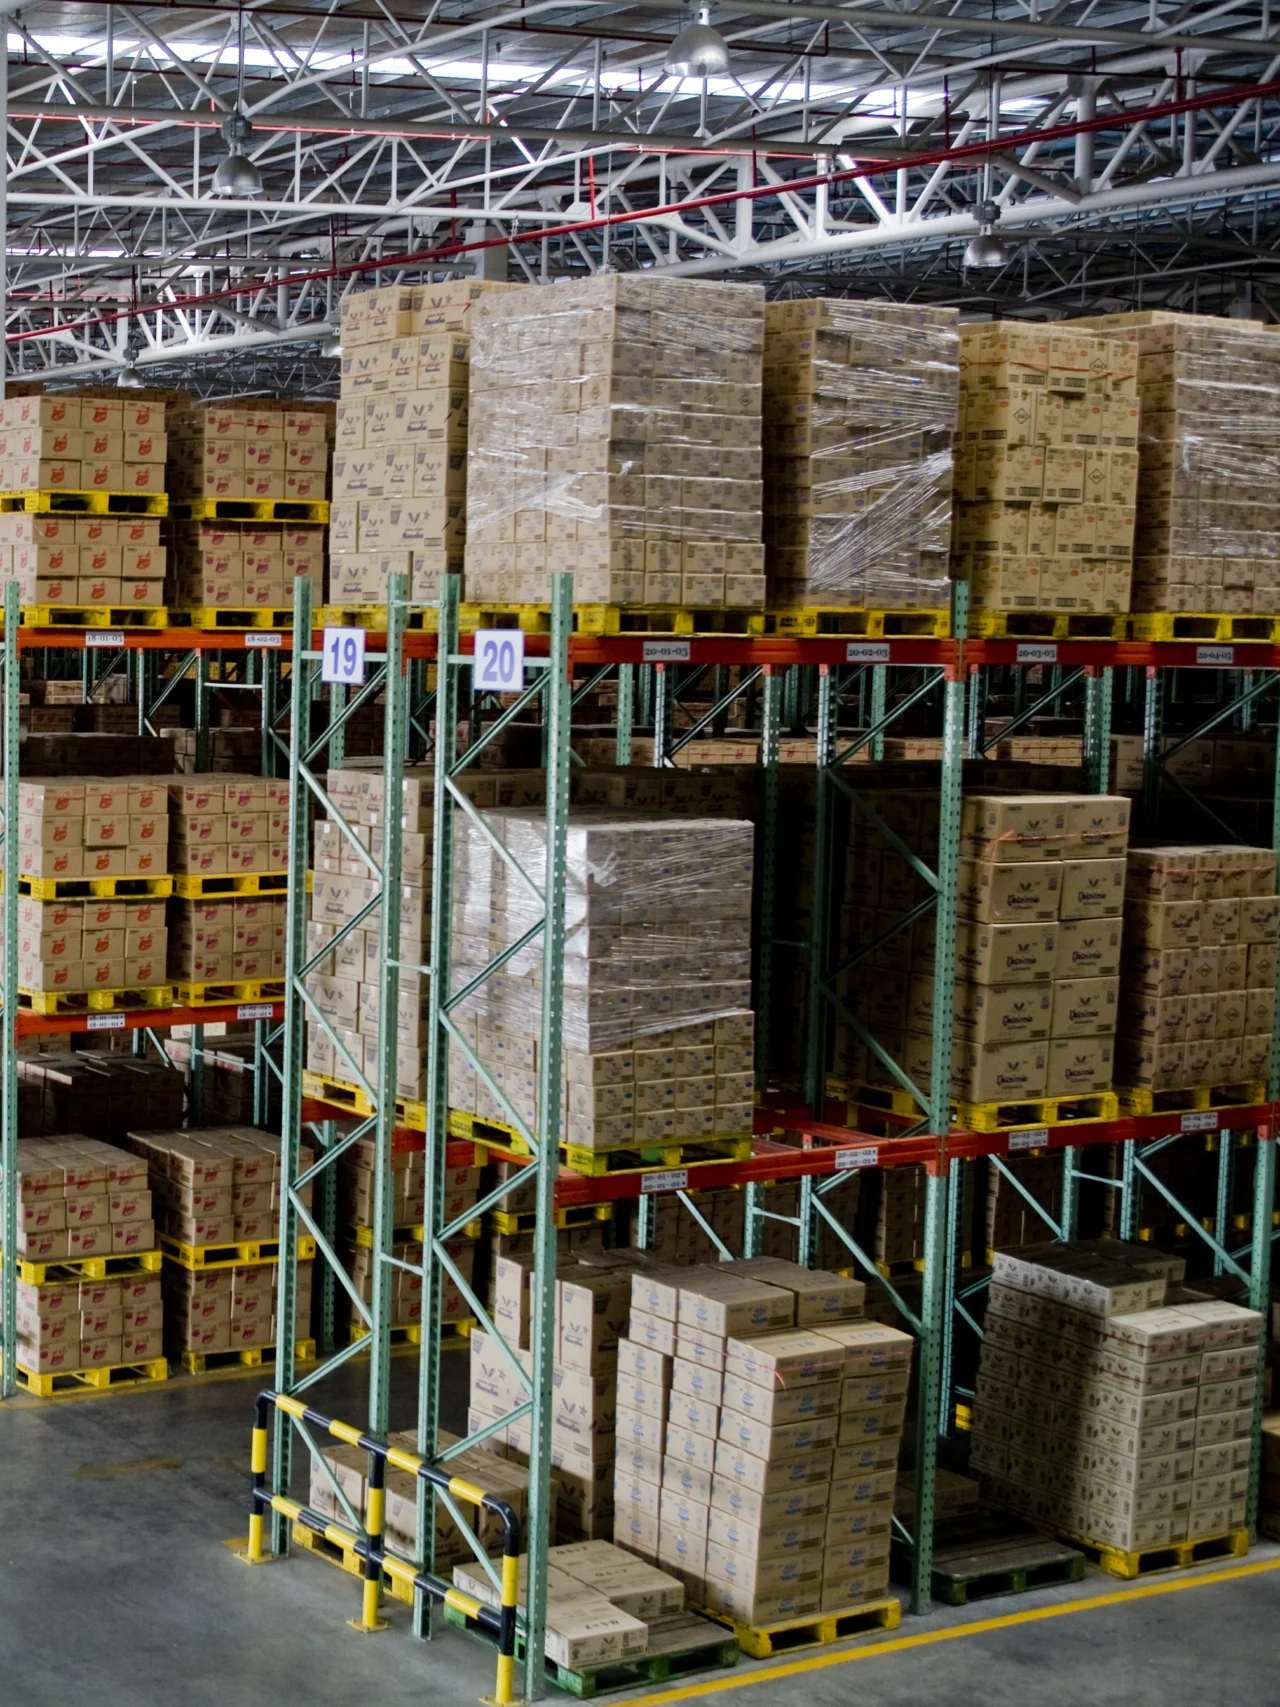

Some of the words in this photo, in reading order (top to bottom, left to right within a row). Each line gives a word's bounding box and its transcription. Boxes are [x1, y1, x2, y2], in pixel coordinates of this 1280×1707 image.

[87, 634, 122, 644] 18-01-03
[247, 635, 280, 645] 18-02-03
[331, 636, 357, 676] 19
[644, 646, 689, 657] 20-01-03
[847, 648, 889, 658] 20-02-03
[1017, 649, 1056, 659] 20-03-03
[1197, 651, 1232, 660] 20-04-03
[482, 640, 515, 683] 20
[837, 1149, 872, 1159] 20-02-02
[837, 1157, 872, 1167] 20-02-01
[643, 1172, 681, 1182] 20-01-02
[643, 1180, 680, 1191] 20-01-01
